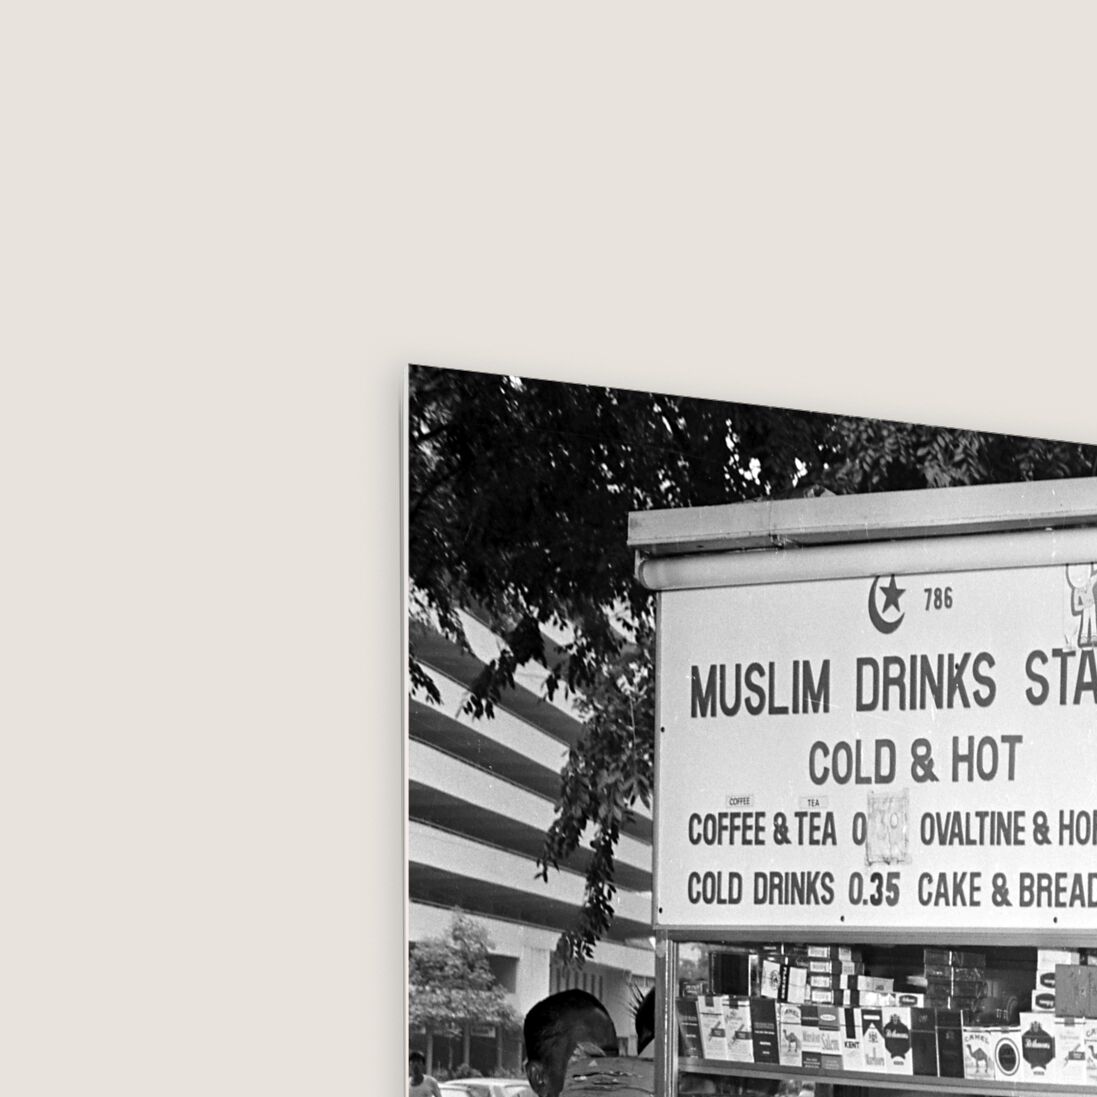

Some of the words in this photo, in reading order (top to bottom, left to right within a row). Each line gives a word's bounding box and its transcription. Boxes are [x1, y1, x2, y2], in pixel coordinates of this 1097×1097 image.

[924, 587, 953, 610] 786
[690, 659, 831, 718] MUSLIM
[855, 652, 996, 711] DRINKS
[809, 738, 896, 785] COLD
[910, 738, 938, 782] &
[951, 735, 1023, 781] HOT
[807, 799, 820, 807] TEA
[688, 811, 766, 845] COFFEE
[773, 811, 792, 845] &
[794, 811, 837, 845] TEA
[920, 811, 1026, 846] OVALTINE
[1032, 811, 1052, 845] &
[687, 871, 743, 905] COLD
[753, 871, 835, 906] DRINKS
[848, 871, 900, 907] 0.35
[918, 872, 982, 907] CAKE
[991, 872, 1012, 907] &
